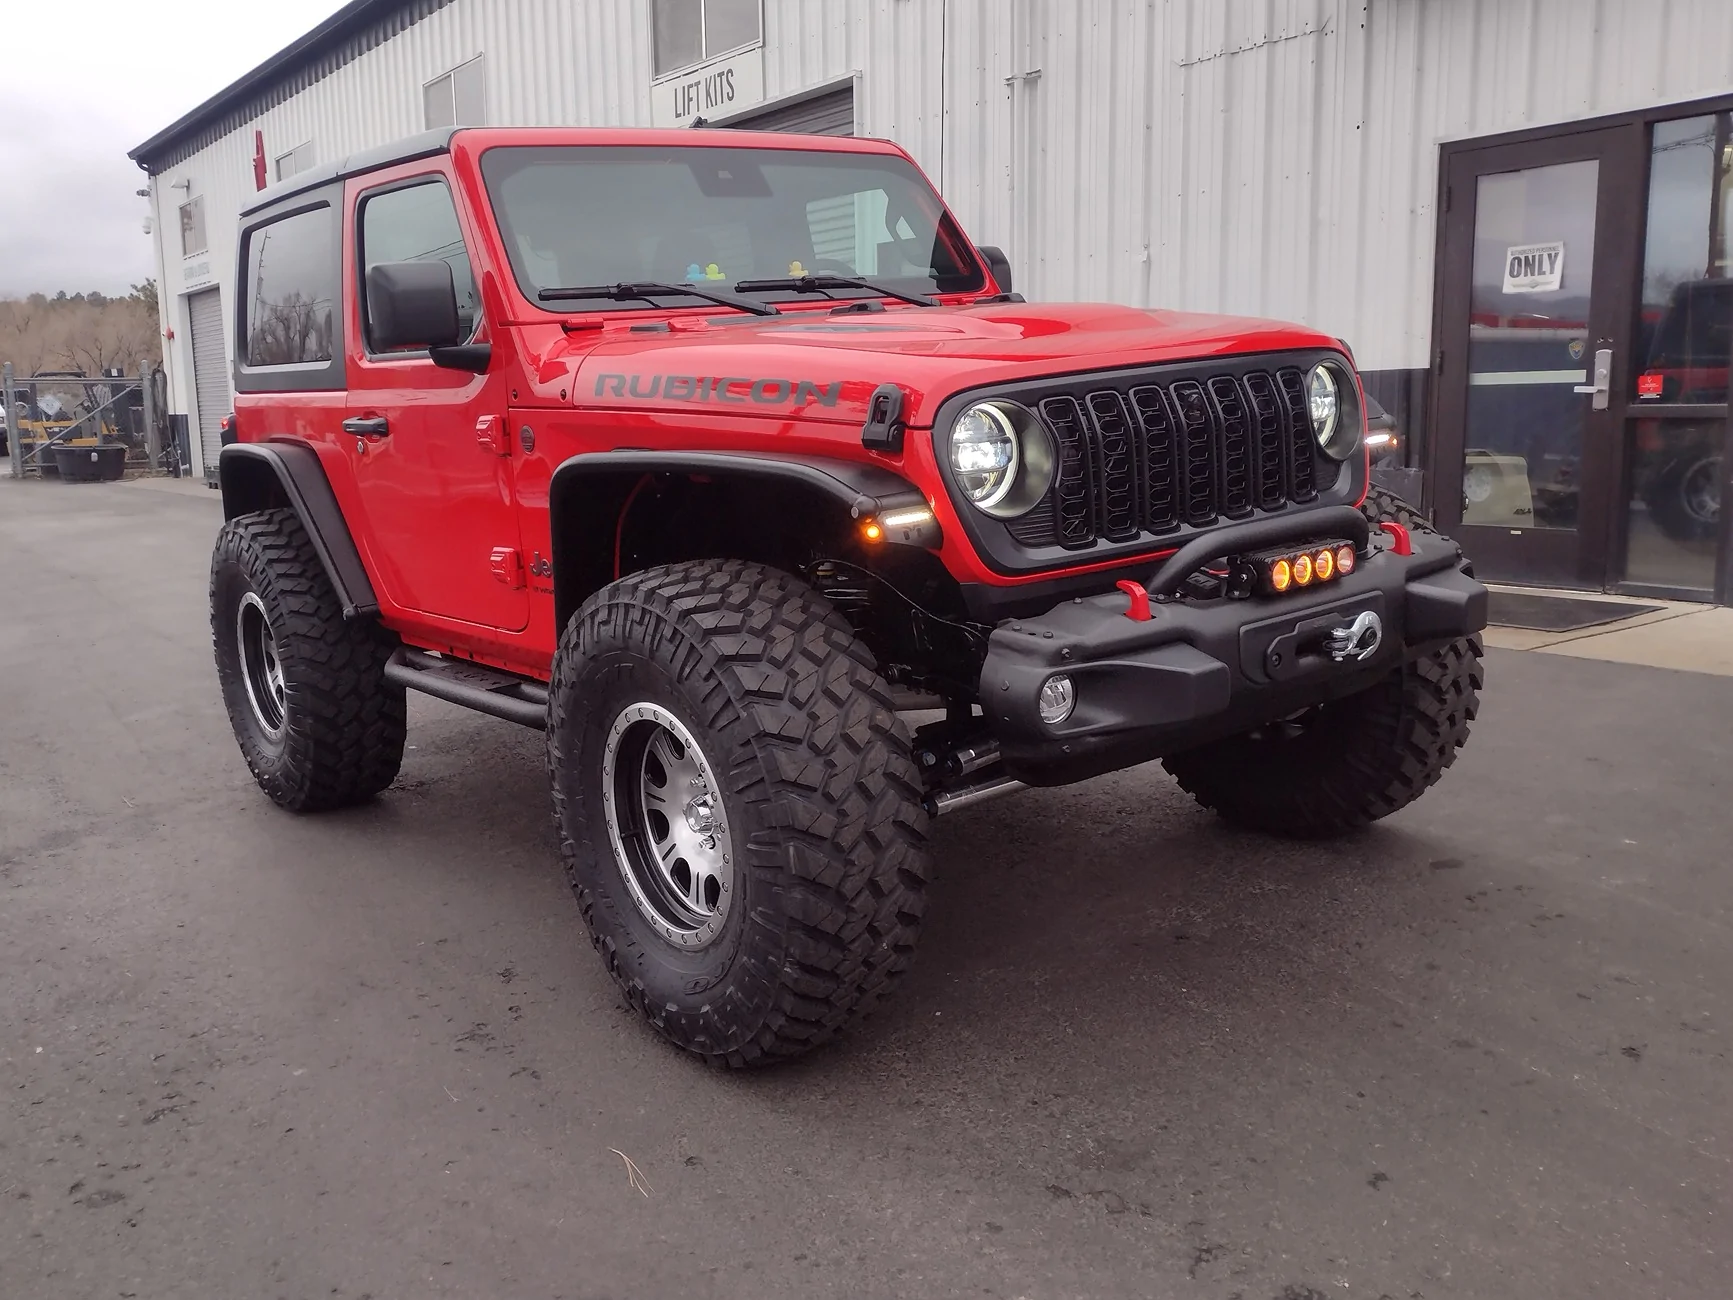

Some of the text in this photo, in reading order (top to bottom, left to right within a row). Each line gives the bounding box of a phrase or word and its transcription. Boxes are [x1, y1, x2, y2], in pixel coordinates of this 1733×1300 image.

[674, 68, 735, 118] LIFT KITS
[1509, 252, 1560, 278] ONLY
[594, 373, 842, 408] RUBICON
